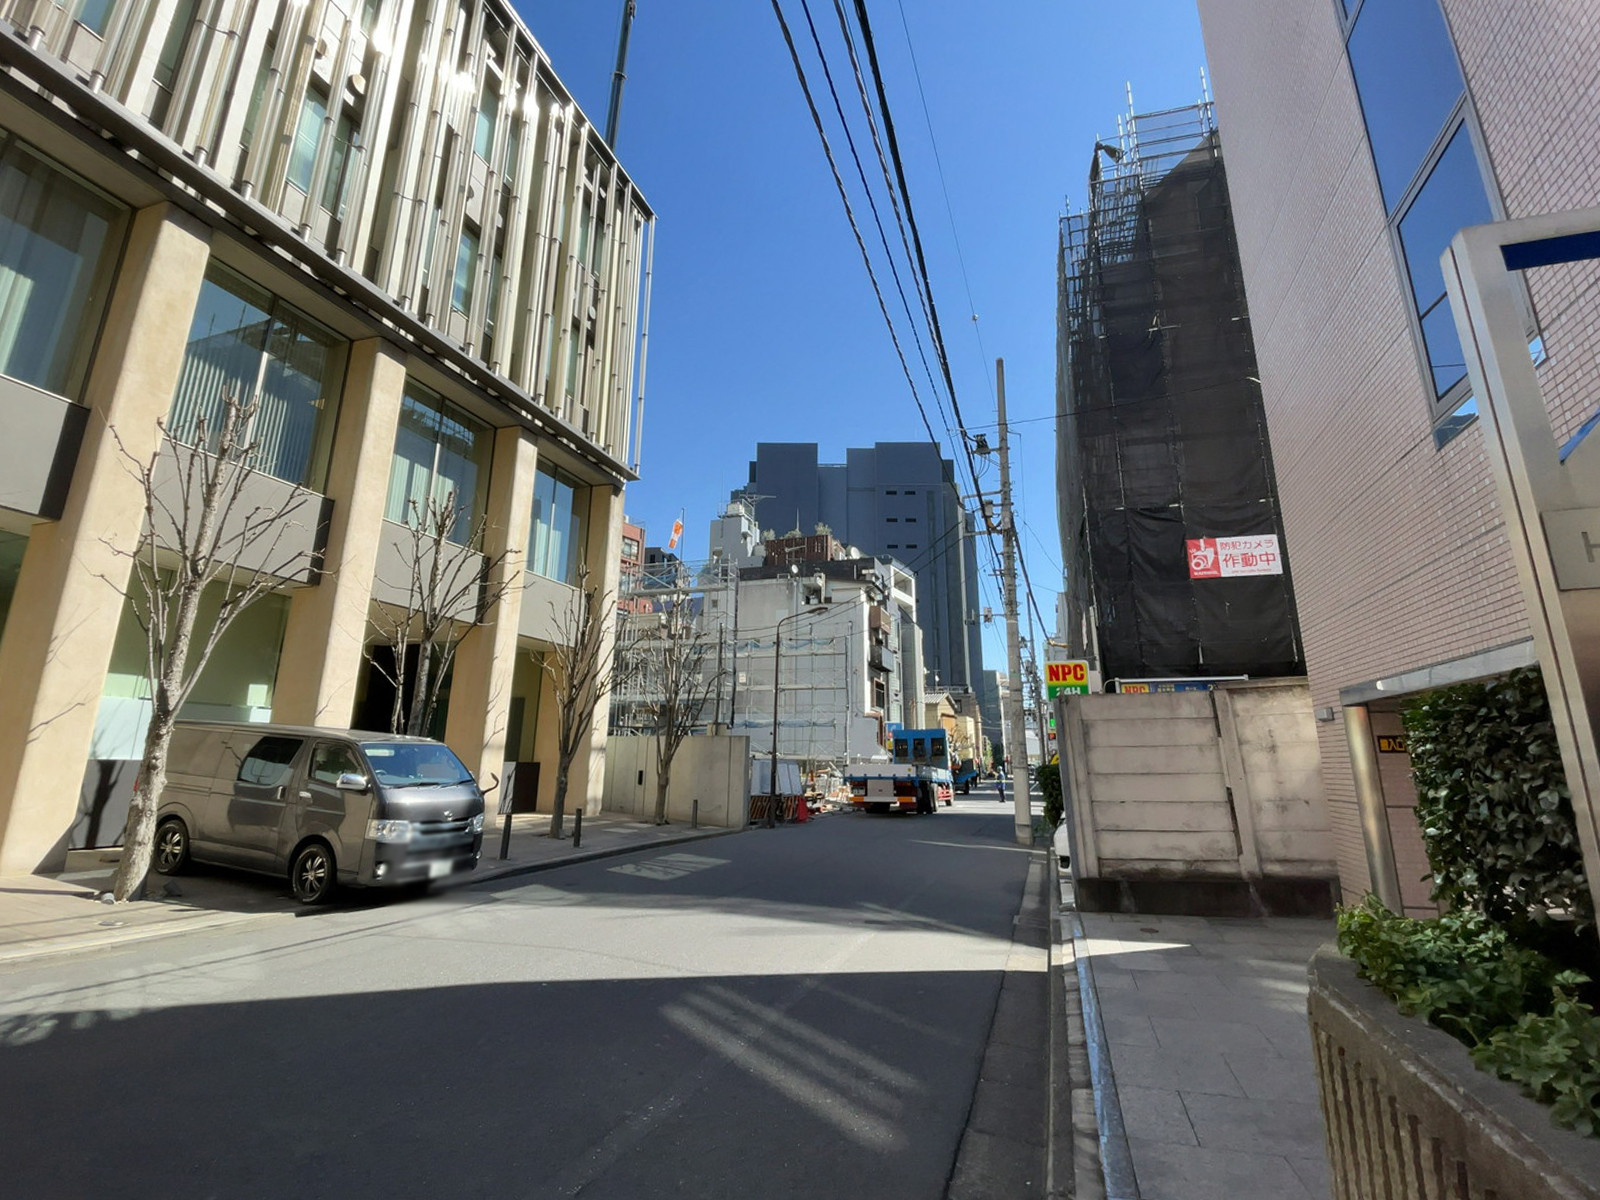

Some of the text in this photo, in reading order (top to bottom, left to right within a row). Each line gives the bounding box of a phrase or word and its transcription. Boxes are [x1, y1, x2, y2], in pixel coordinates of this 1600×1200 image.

[1220, 540, 1274, 551] 防犯カメラ
[1223, 551, 1276, 568] 作動中
[1048, 663, 1085, 682] NPC
